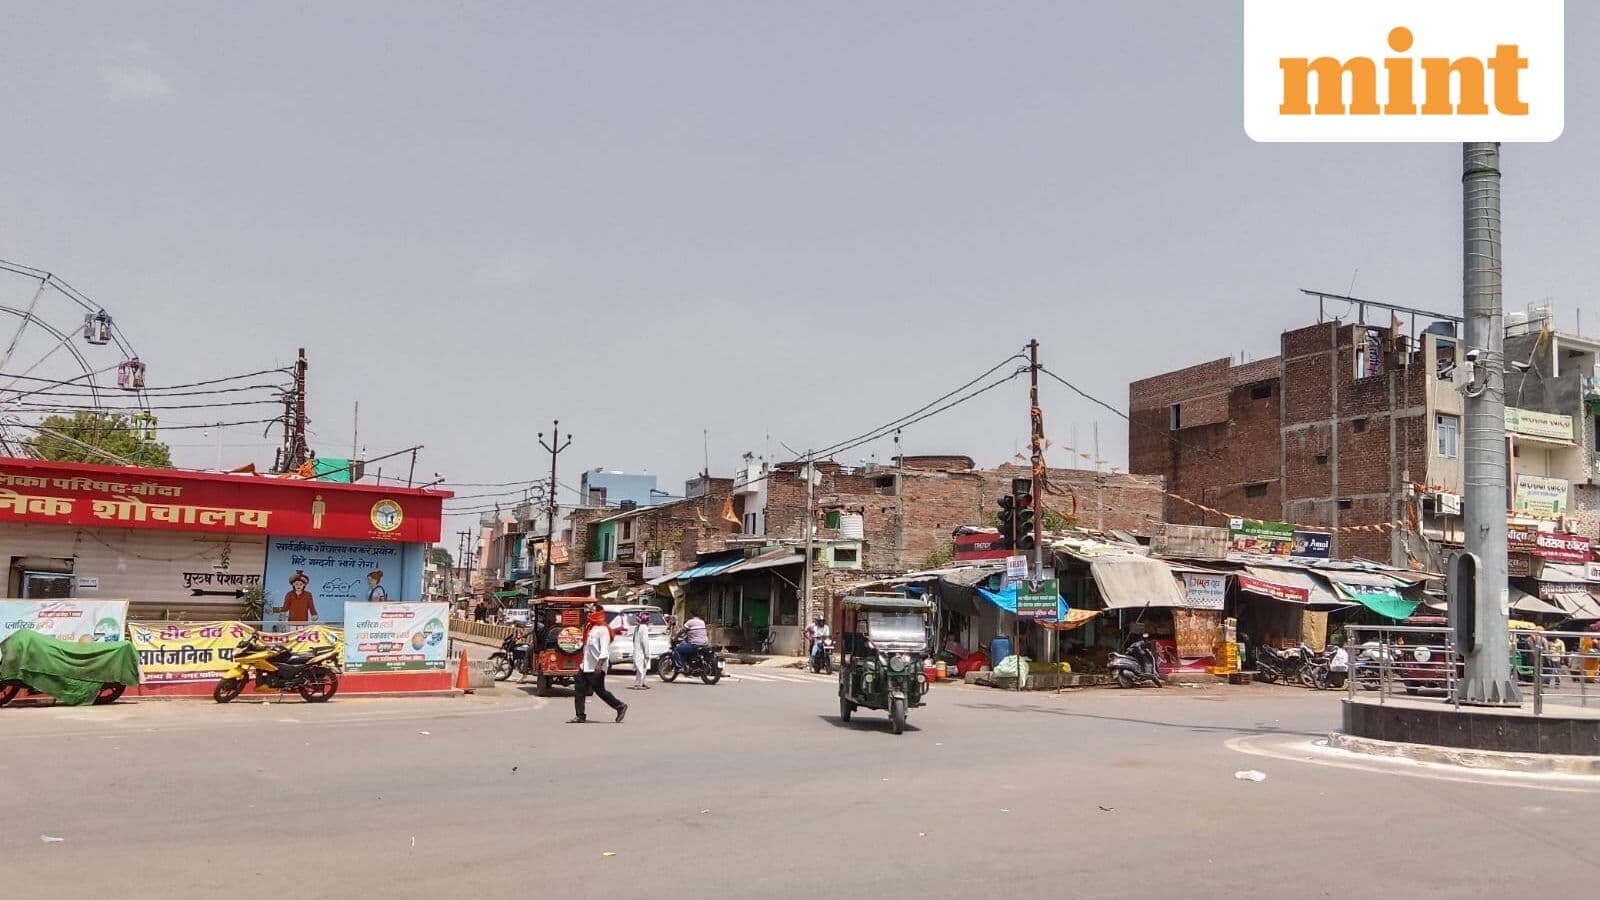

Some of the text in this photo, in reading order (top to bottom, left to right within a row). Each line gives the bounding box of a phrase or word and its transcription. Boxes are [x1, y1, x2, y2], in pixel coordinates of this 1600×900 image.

[92, 495, 273, 528] शौचालय
[275, 541, 313, 553] सार्वजनिक
[246, 574, 261, 585] घर
[138, 645, 213, 665] सार्वजनिक
